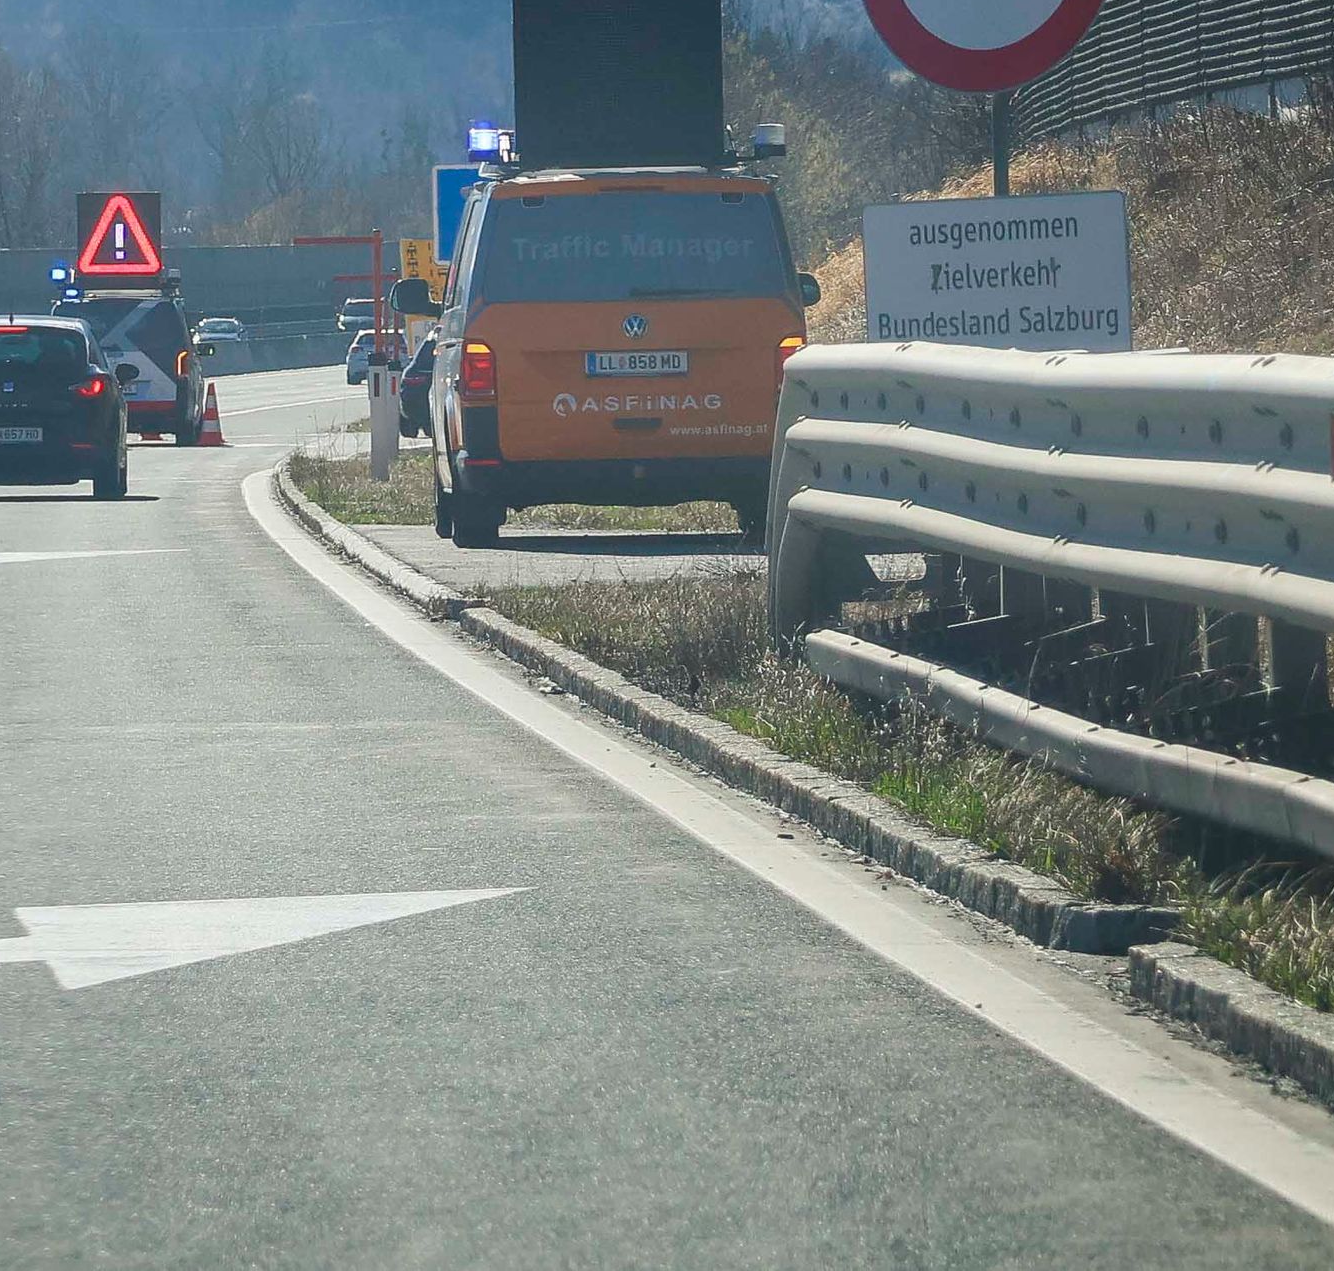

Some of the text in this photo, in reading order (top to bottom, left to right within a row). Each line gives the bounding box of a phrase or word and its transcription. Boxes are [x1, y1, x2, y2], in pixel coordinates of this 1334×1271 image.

[512, 232, 754, 263] Traffic Manager
[909, 215, 1079, 250] ausgenommen
[930, 256, 1062, 294] Zielverkehr
[878, 304, 1119, 340] Bundesland Salzburg
[600, 354, 681, 370] LL 858 MD
